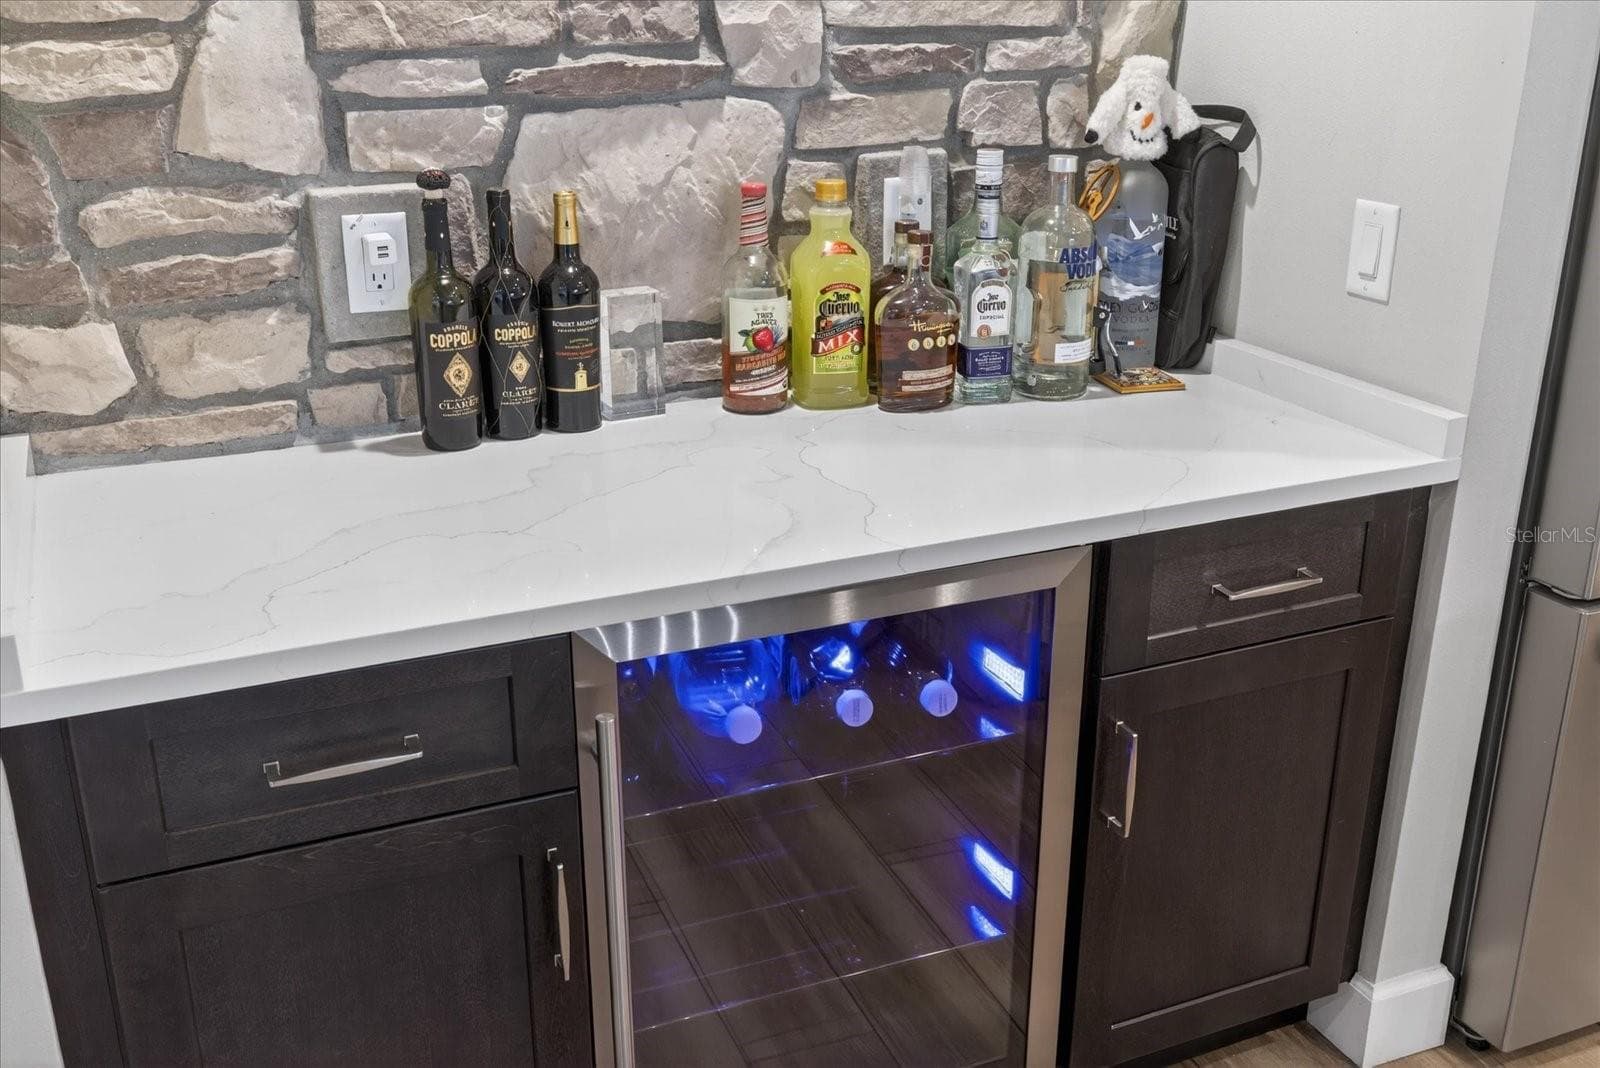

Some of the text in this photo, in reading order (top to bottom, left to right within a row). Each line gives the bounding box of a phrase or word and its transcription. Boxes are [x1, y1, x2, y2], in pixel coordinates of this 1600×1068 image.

[819, 298, 860, 317] Cuervo
[976, 298, 1007, 313] Cuervo
[818, 329, 860, 354] MIX
